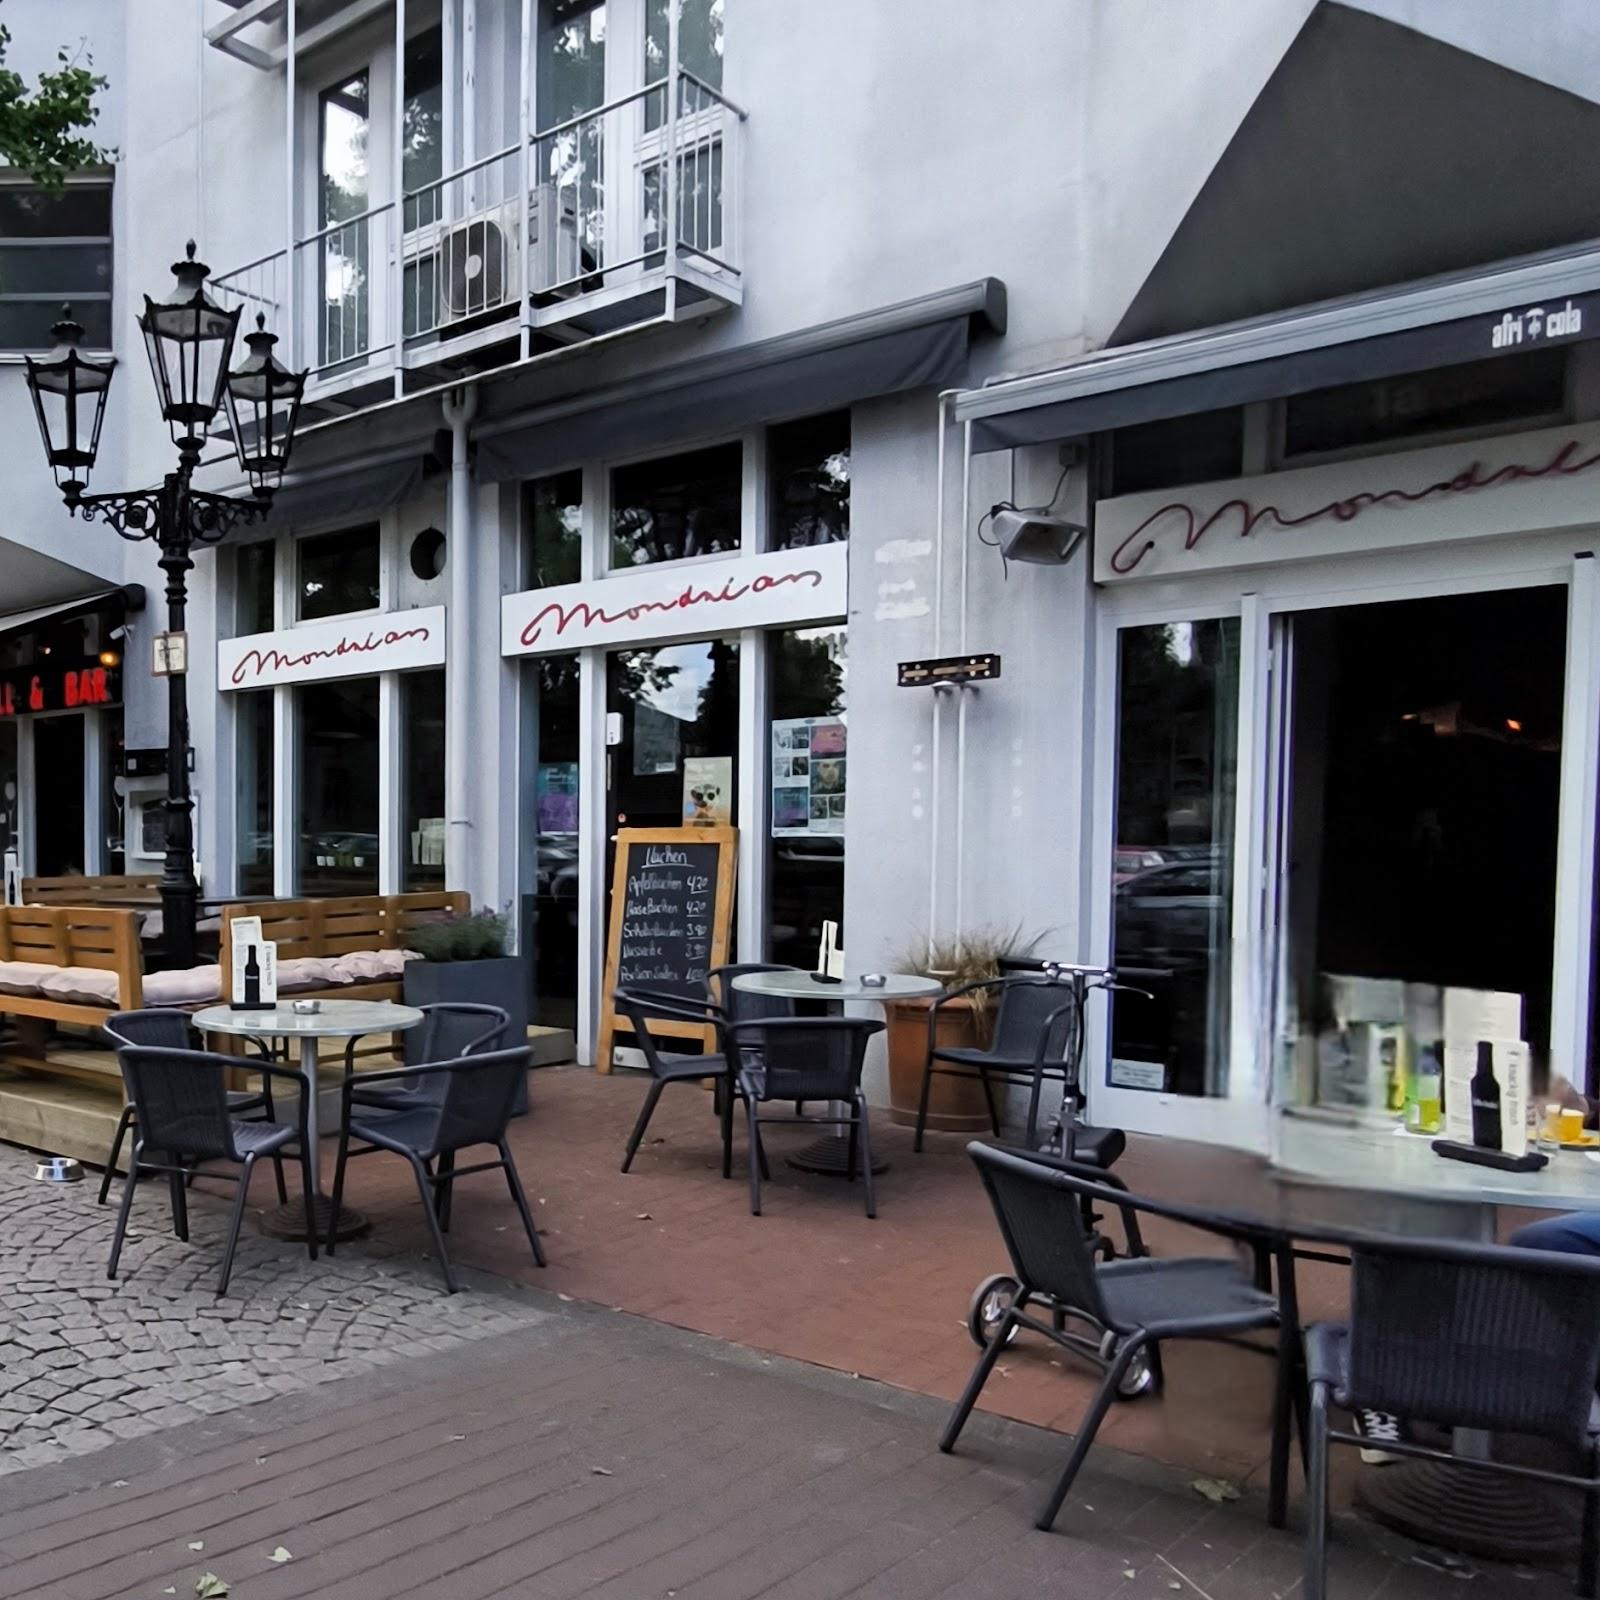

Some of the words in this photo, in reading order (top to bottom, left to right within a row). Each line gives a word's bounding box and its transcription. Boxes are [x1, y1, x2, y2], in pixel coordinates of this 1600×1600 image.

[1491, 312, 1523, 348] afri
[1546, 300, 1582, 337] cola
[1111, 440, 1600, 574] Mondri
[520, 569, 822, 646] Mondrian
[231, 627, 430, 684] Mondrian
[65, 667, 109, 707] BAR
